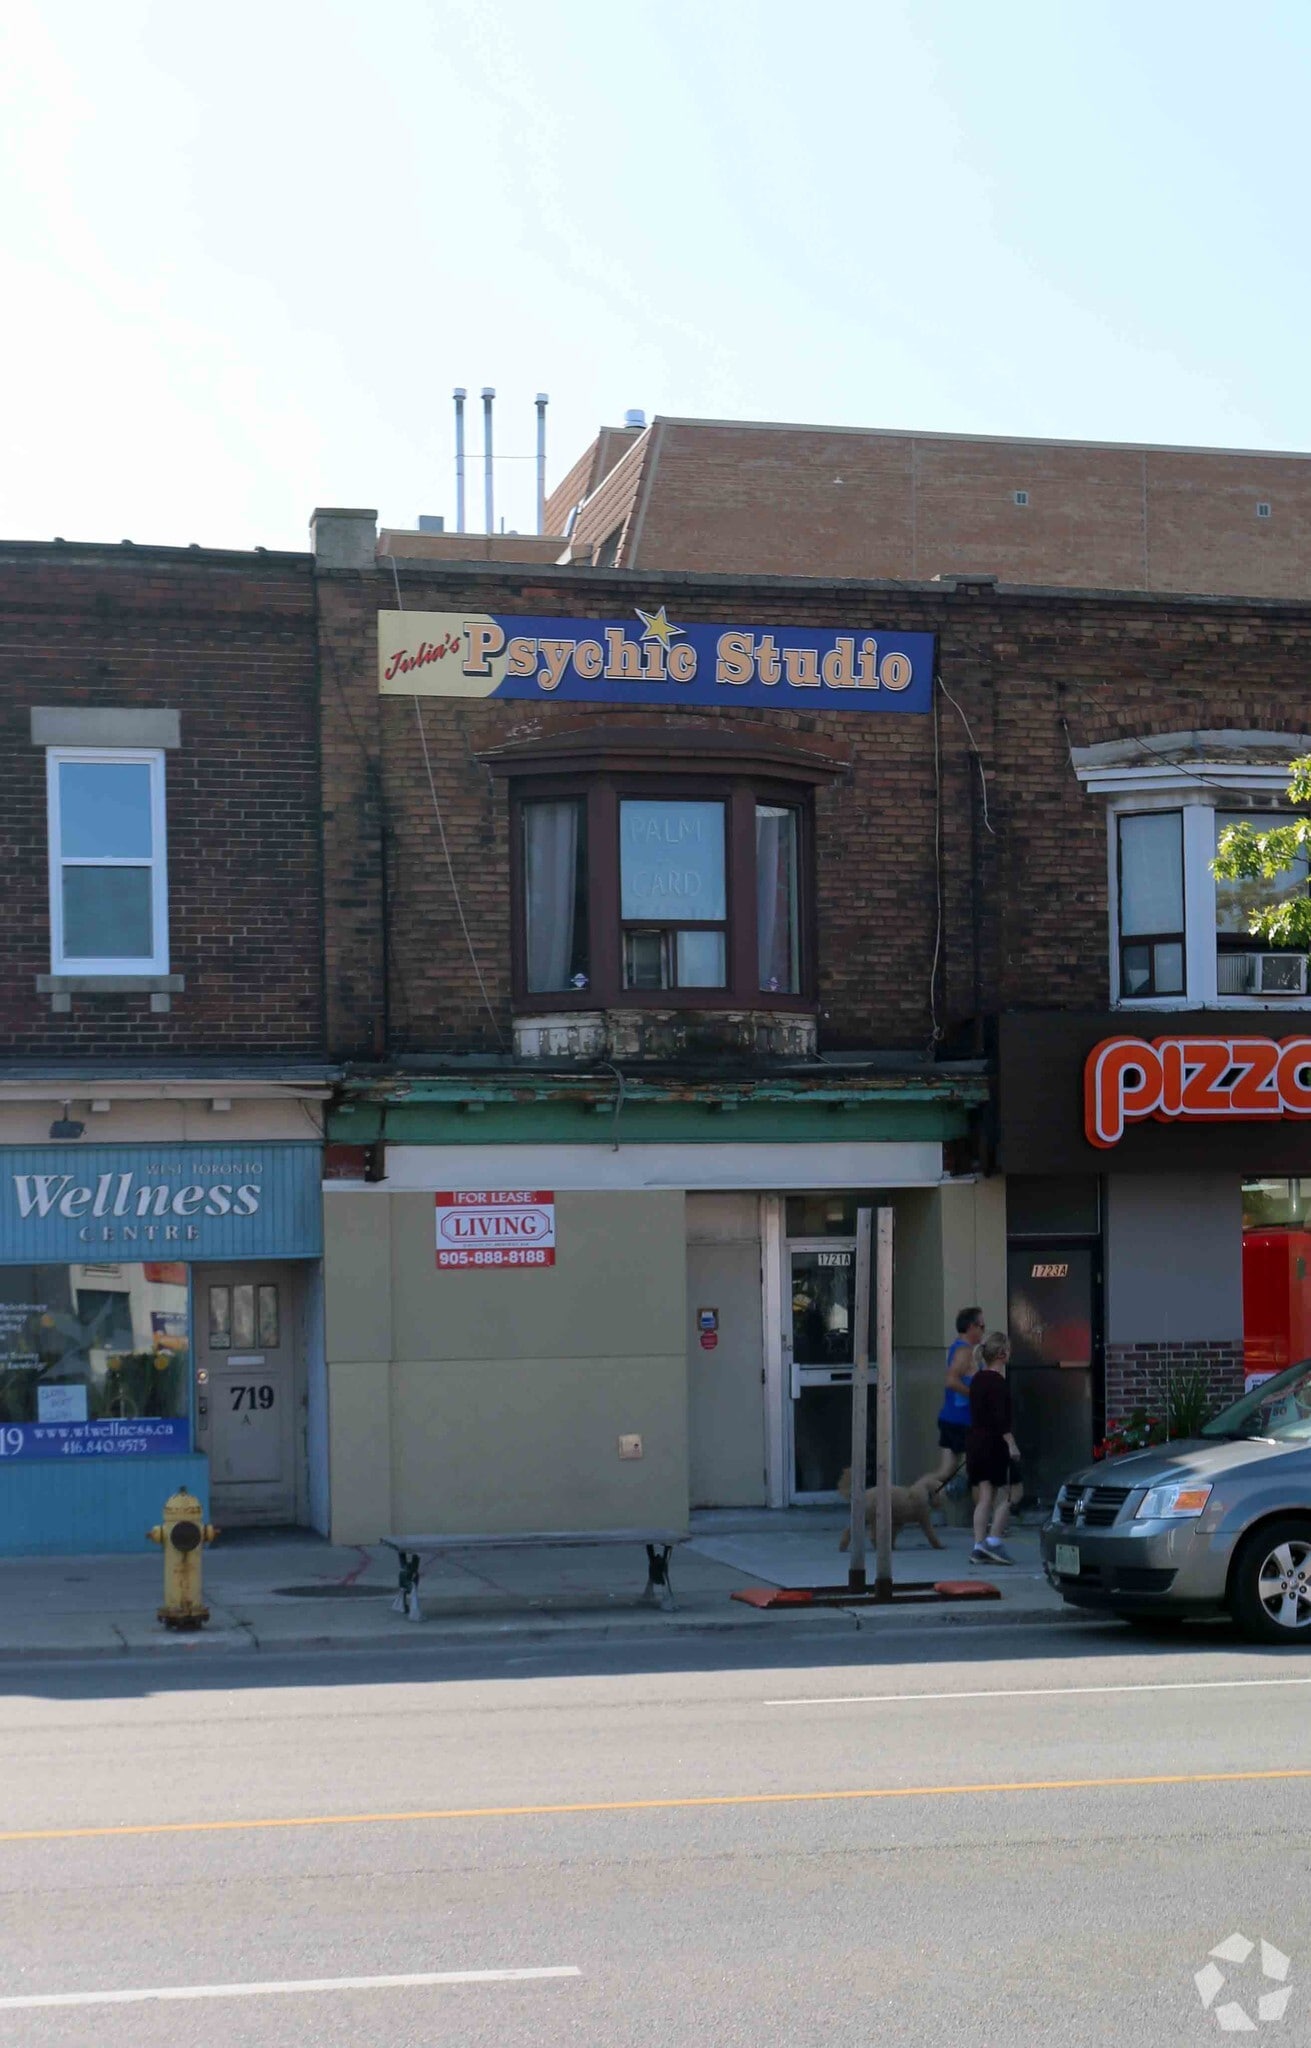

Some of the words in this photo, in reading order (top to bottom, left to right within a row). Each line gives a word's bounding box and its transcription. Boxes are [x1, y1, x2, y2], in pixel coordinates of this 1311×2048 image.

[384, 632, 461, 680] Julia's
[462, 621, 697, 690] Psychic
[716, 631, 913, 691] Studio
[631, 817, 702, 843] PALM
[632, 870, 702, 897] CARD
[146, 1162, 183, 1176] WEST
[191, 1162, 263, 1176] TORONTO
[12, 1172, 262, 1219] Wellness
[458, 1191, 488, 1204] FOR
[491, 1190, 533, 1203] LEASE
[79, 1225, 201, 1242] CENTRE
[454, 1215, 537, 1237] LIVING
[819, 1254, 850, 1266] 1721A
[1033, 1264, 1067, 1277] 1723A
[230, 1385, 275, 1411] 719
